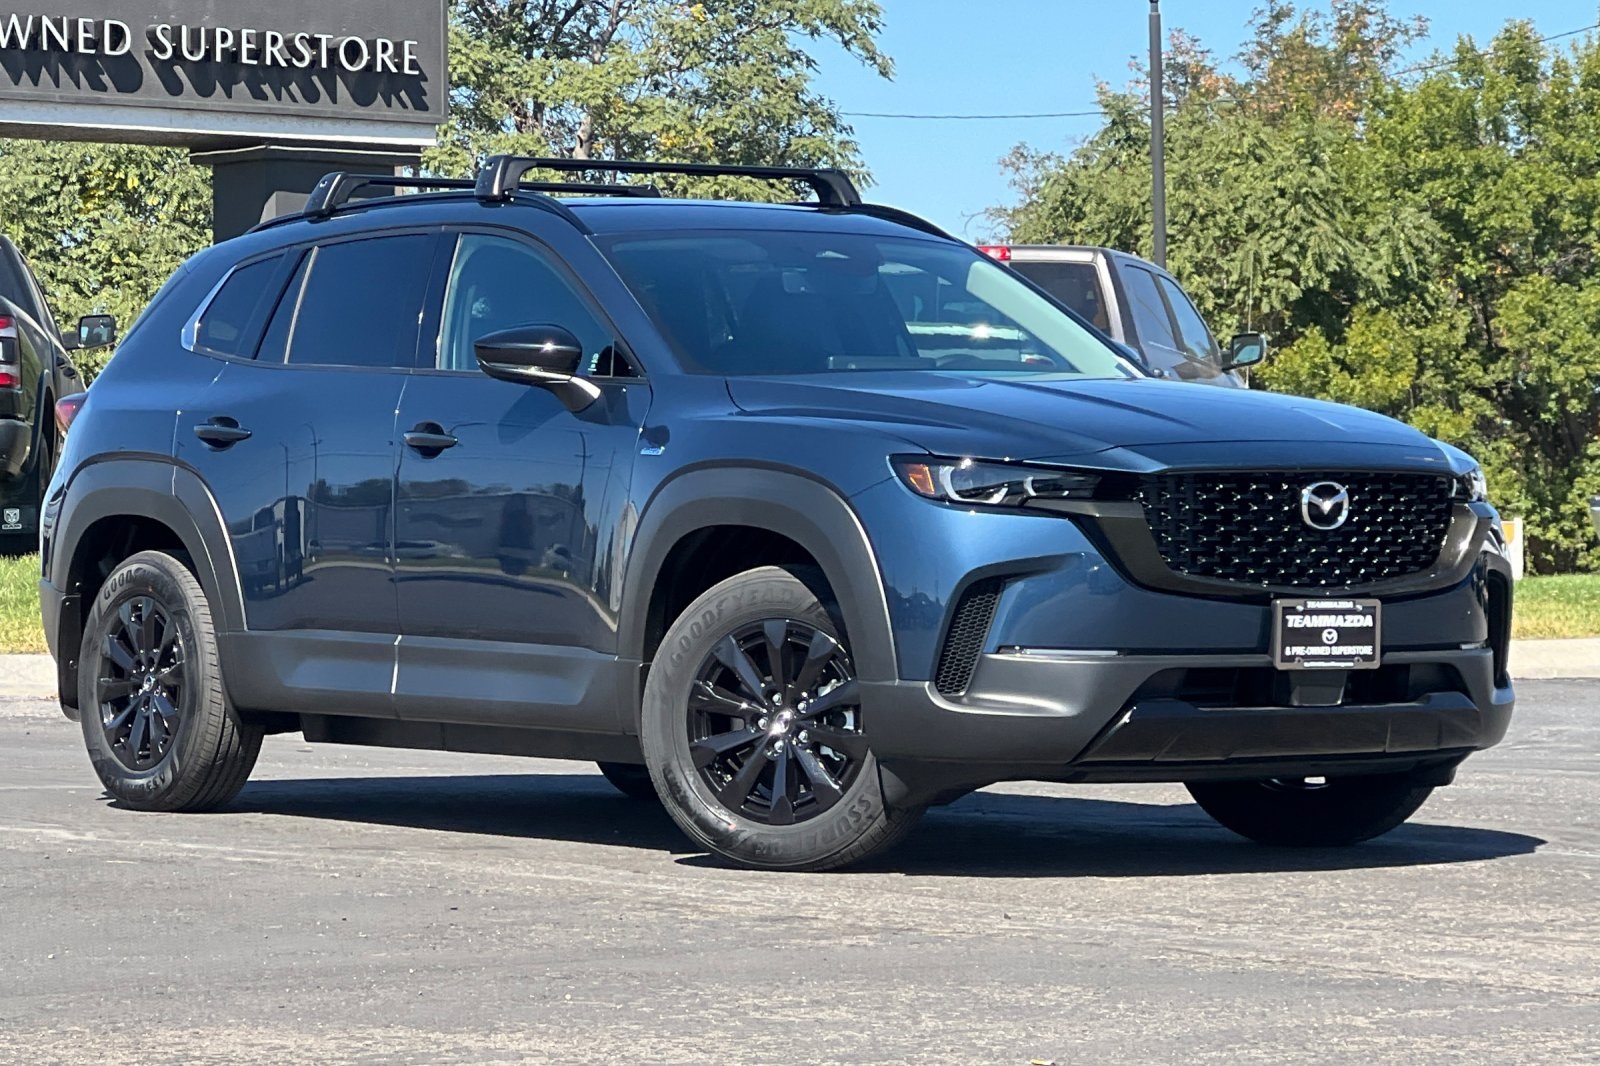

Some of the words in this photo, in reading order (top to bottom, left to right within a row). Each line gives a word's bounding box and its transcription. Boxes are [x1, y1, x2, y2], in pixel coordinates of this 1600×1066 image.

[0, 13, 131, 56] WNED
[152, 23, 420, 76] SUPERSTORE
[1285, 614, 1374, 628] TEAMMAZDA
[1331, 645, 1373, 656] SUPERSTORE
